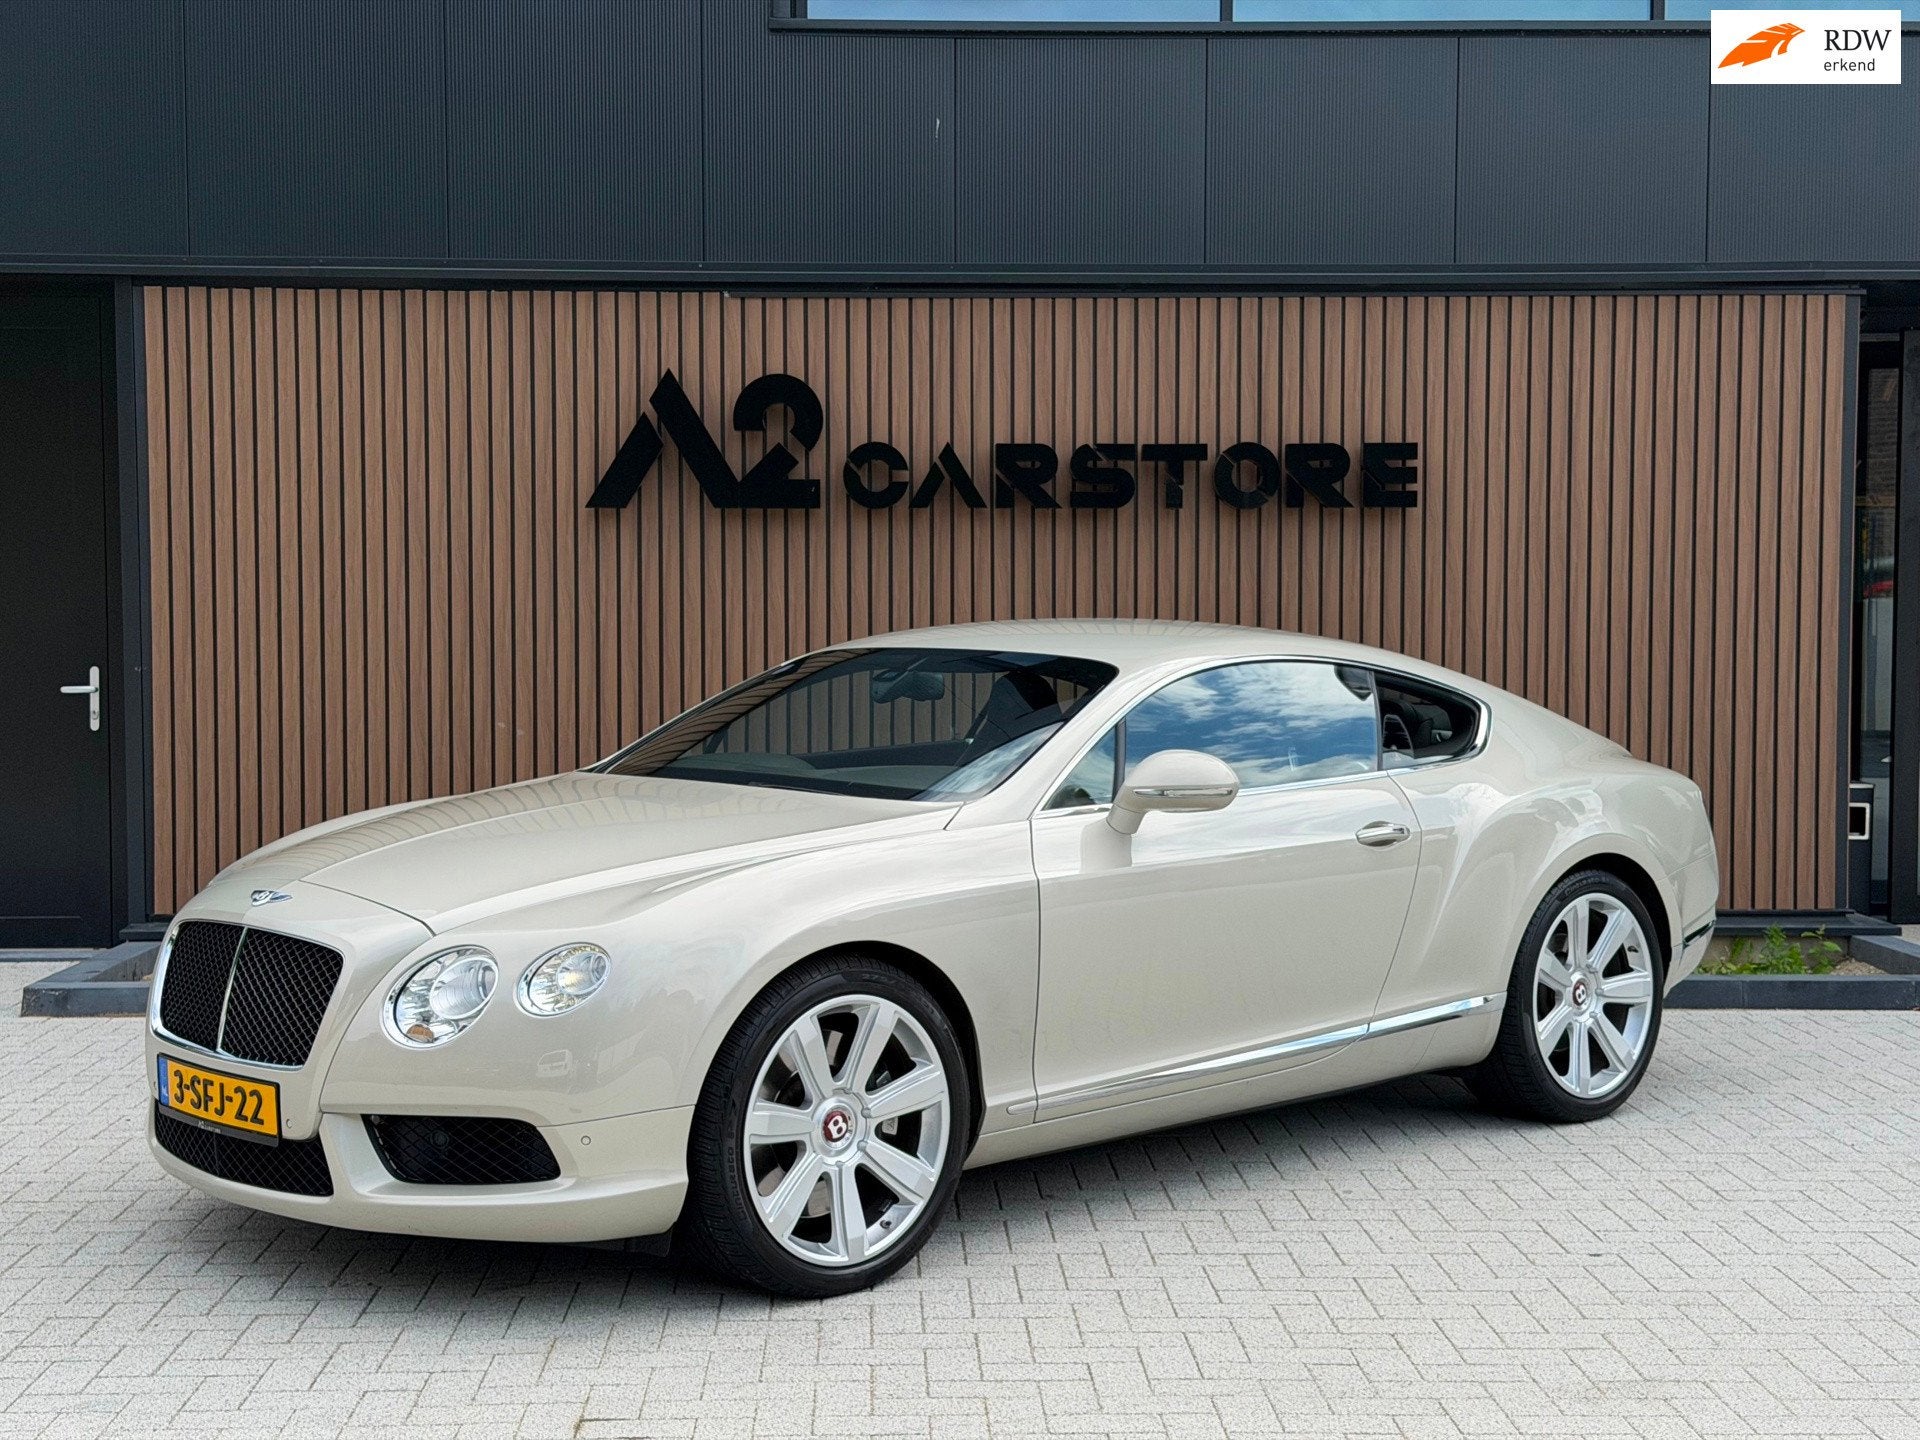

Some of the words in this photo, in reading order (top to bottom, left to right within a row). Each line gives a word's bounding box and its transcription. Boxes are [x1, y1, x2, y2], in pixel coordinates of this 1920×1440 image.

[585, 368, 824, 509] A2
[842, 441, 1418, 509] CARSTORE
[173, 1069, 265, 1126] 3-SFJ-22
[827, 1115, 847, 1139] B
